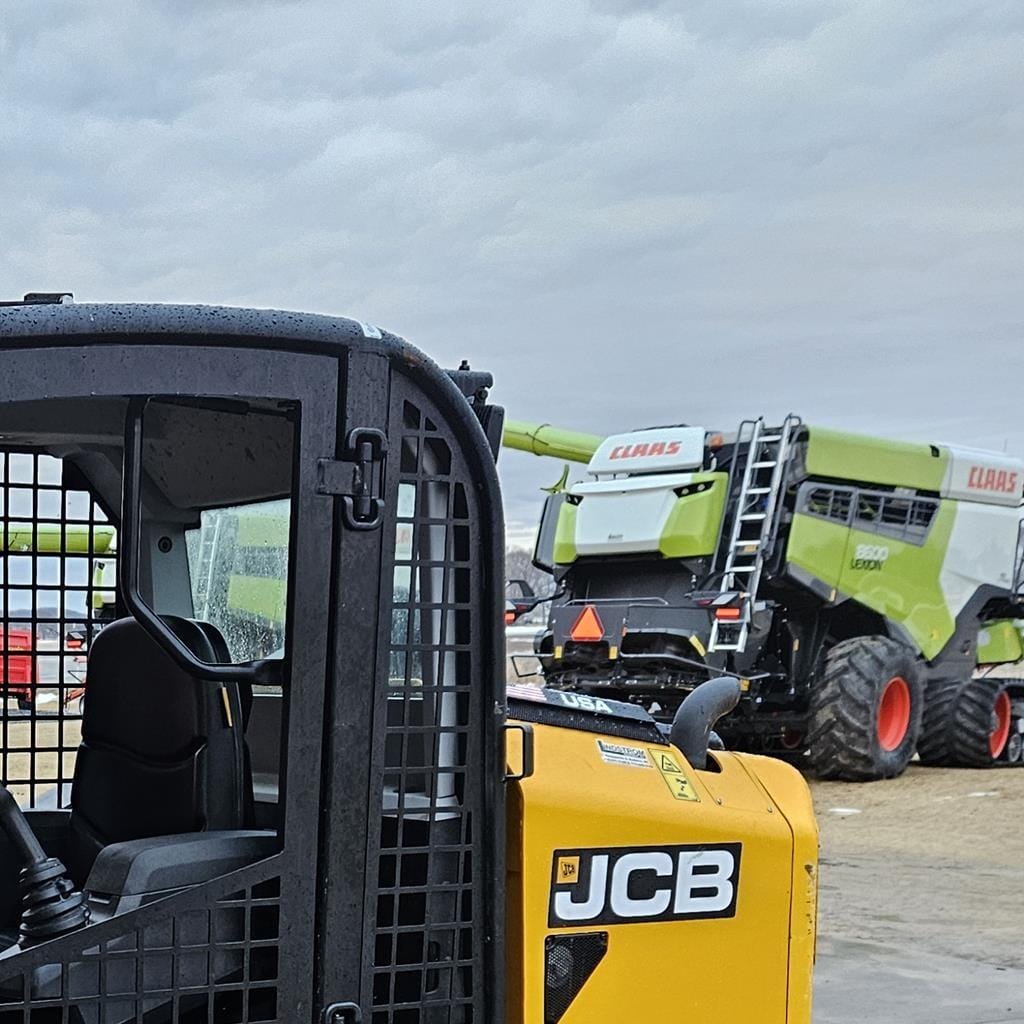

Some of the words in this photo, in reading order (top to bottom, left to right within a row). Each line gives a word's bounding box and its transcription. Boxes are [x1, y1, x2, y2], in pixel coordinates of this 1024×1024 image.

[609, 441, 682, 460] CLAAS
[968, 466, 1018, 493] CLAAS
[560, 693, 613, 713] USA
[555, 850, 735, 921] JCB
